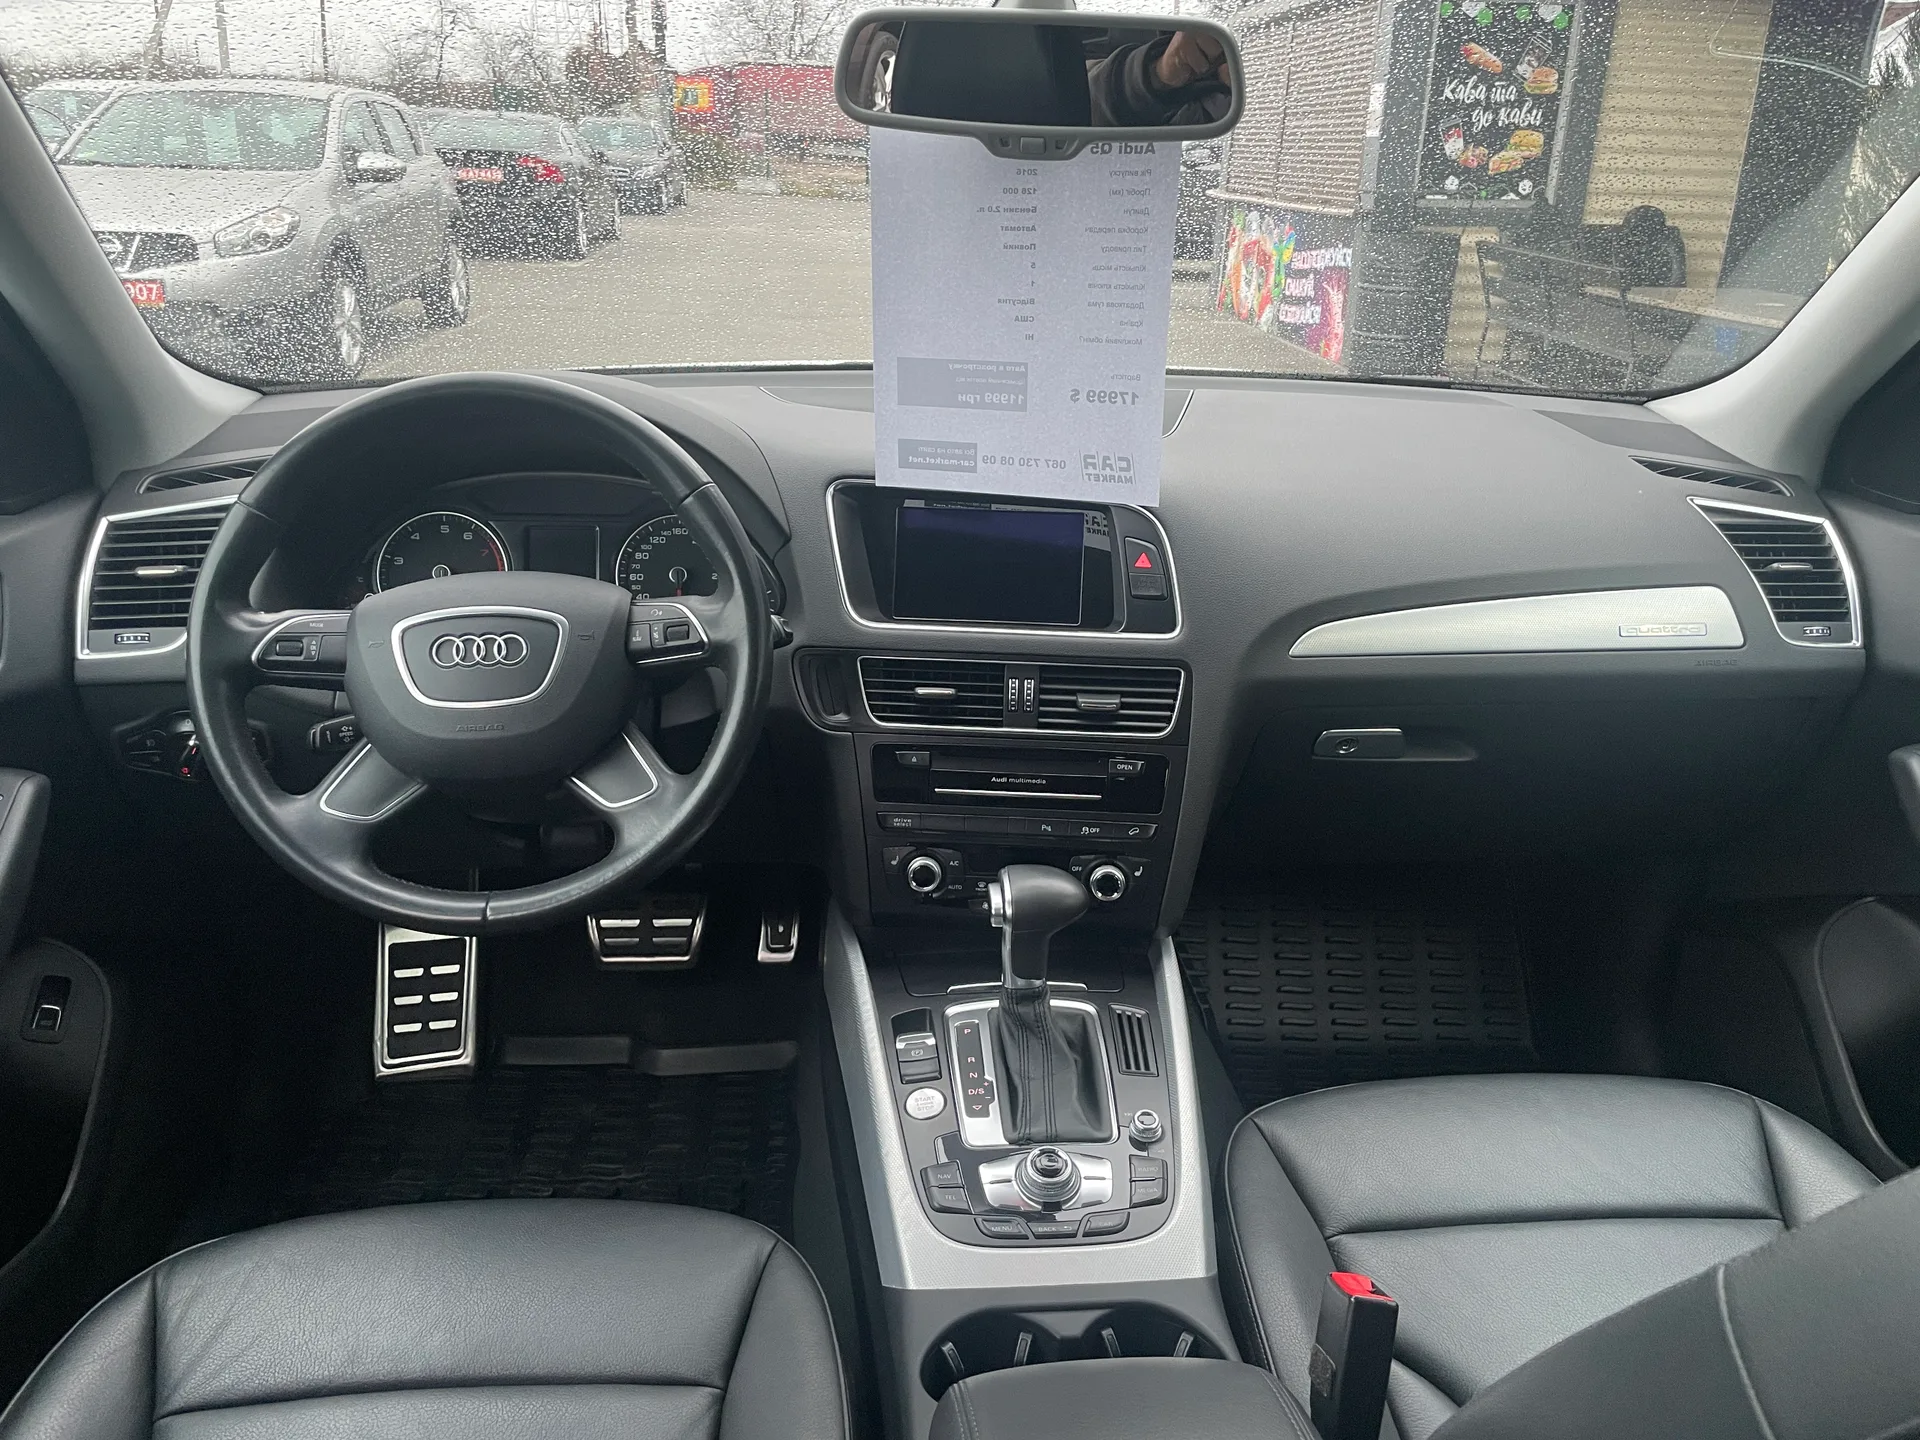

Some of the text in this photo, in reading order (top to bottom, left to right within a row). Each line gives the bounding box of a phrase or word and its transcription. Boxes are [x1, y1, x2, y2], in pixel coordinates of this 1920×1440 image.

[1441, 75, 1487, 104] Кава
[1472, 98, 1543, 132] до кави
[440, 525, 450, 533] 5
[671, 527, 689, 535] 160
[410, 532, 420, 540] 4
[463, 532, 473, 540] 6
[649, 536, 666, 544] 120
[635, 552, 649, 560] 80
[393, 557, 404, 565] 3
[629, 573, 644, 581] 60
[1626, 625, 1701, 637] quattro
[455, 723, 505, 732] AIRBAG
